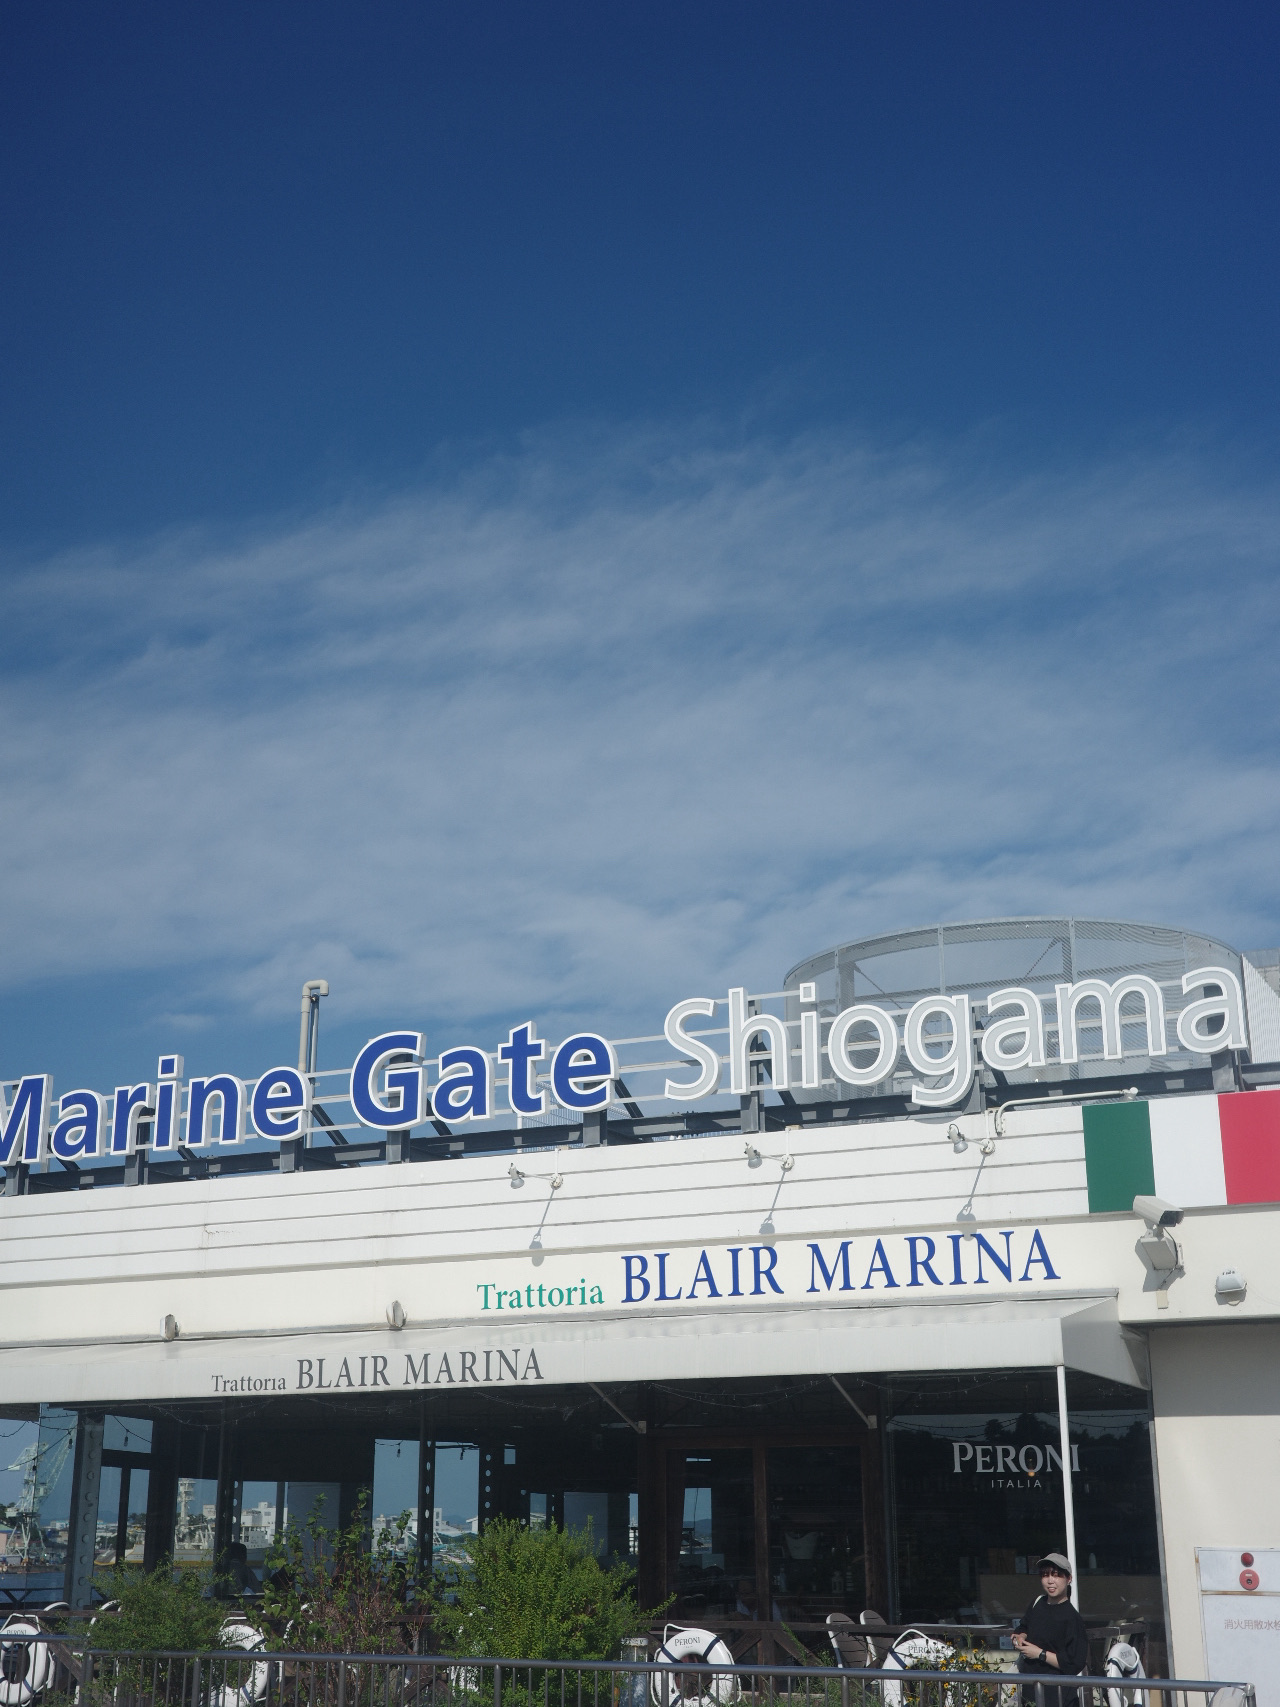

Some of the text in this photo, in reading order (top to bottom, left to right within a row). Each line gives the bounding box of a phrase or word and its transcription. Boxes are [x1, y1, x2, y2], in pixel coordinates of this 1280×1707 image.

[349, 1021, 619, 1130] Gate
[664, 966, 1249, 1106] Shiogama
[477, 1229, 1061, 1310] Trattoria BLAIR MARINA
[211, 1348, 545, 1392] Trattoria BLAIR MARINA
[952, 1442, 1081, 1473] PERONI
[991, 1479, 1042, 1488] ITALIA
[674, 1637, 700, 1646] PERONI
